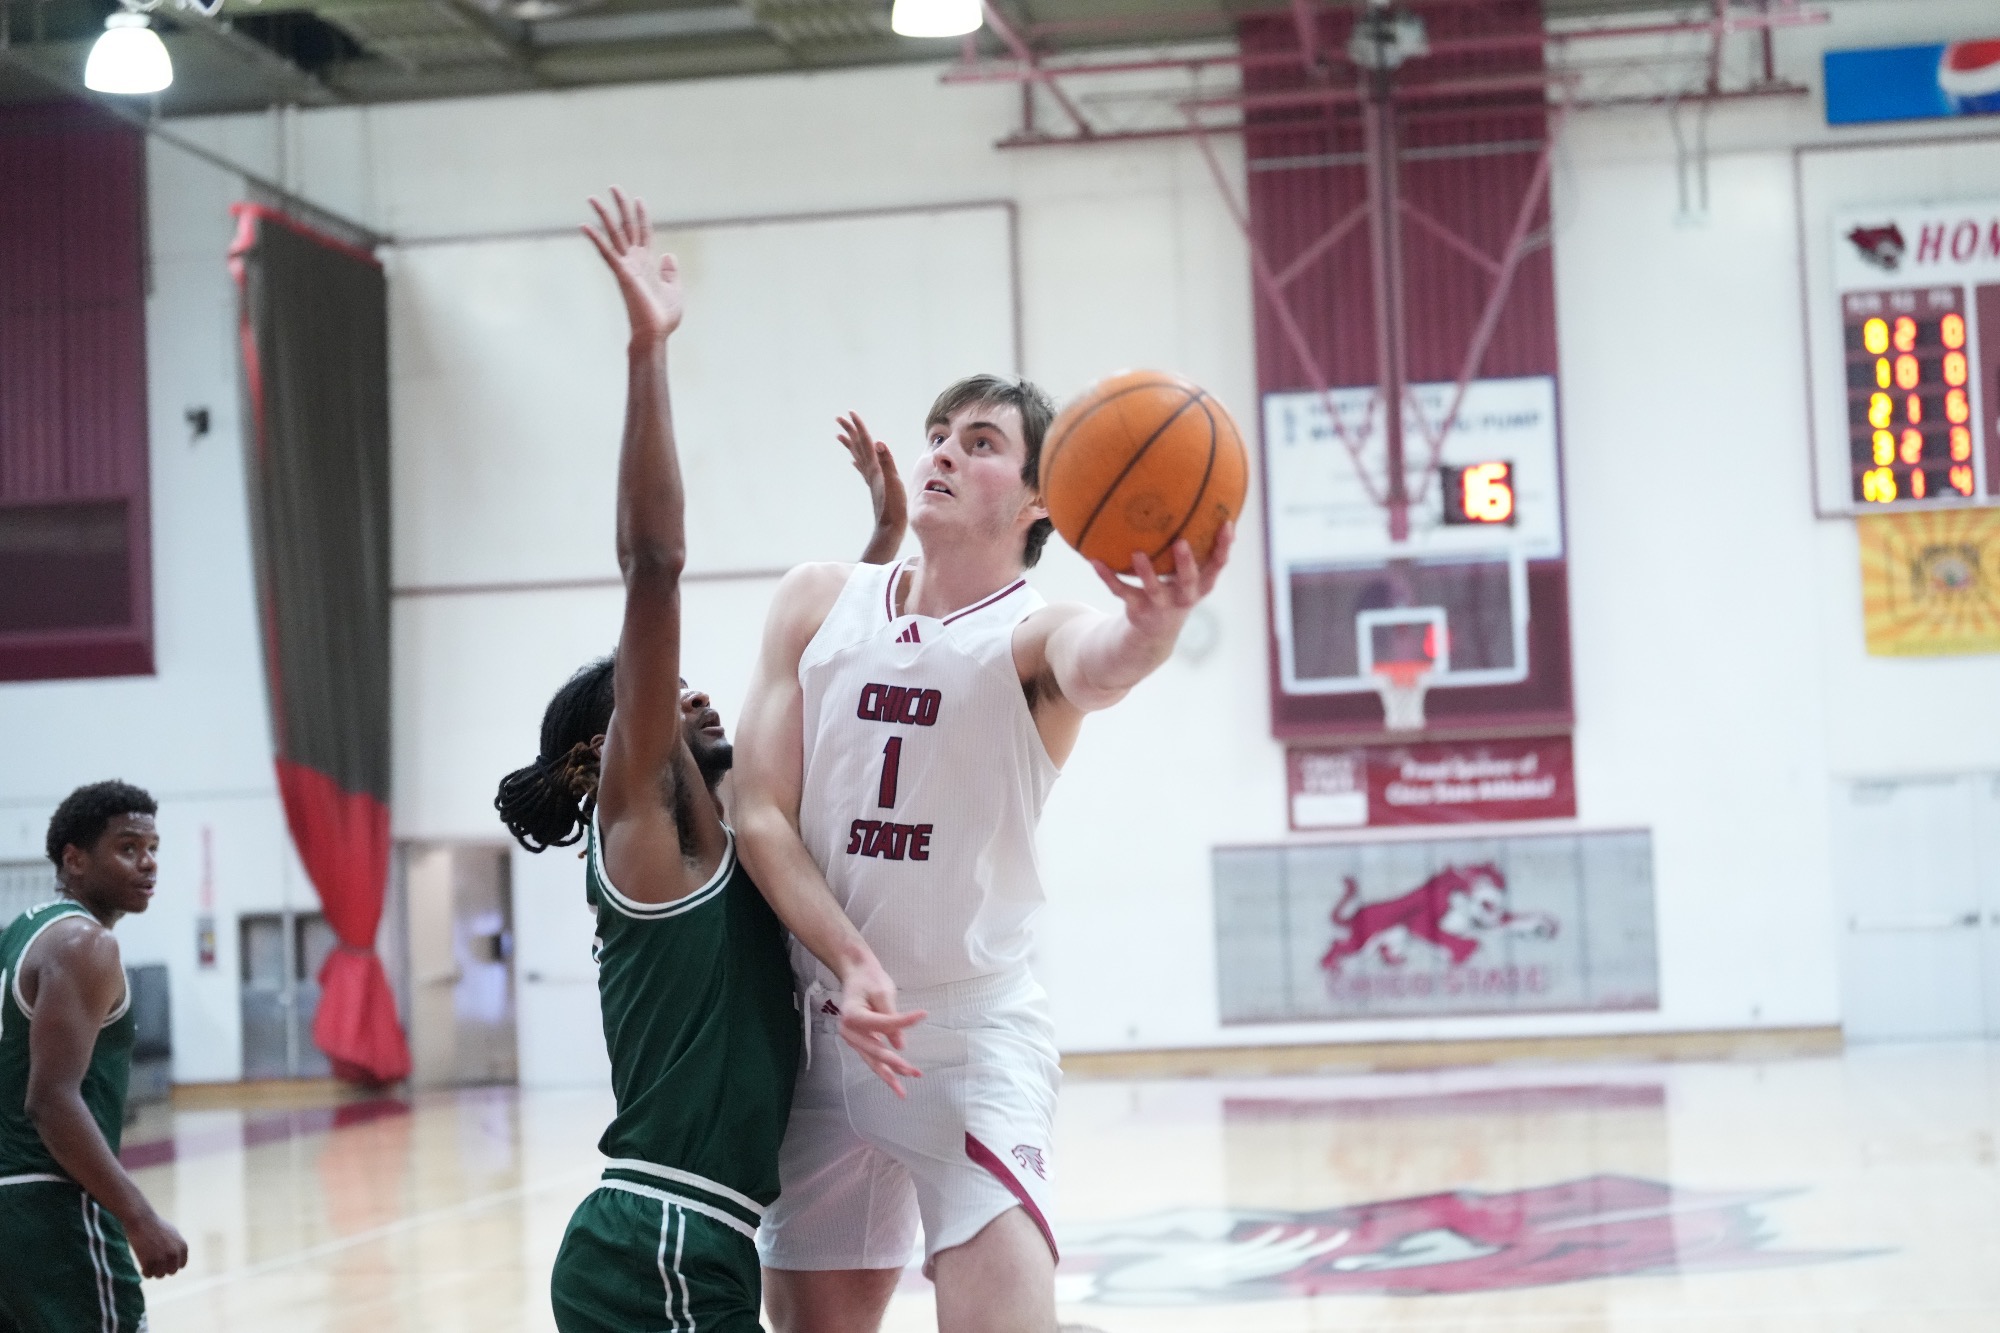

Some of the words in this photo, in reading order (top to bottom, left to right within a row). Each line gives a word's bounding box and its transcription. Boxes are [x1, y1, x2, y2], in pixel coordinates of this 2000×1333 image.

[1864, 317, 1889, 354] 0
[1893, 315, 1917, 352] 2
[1876, 357, 1891, 389] 1
[1907, 393, 1922, 425] 1
[1900, 428, 1923, 464] 2
[1461, 461, 1515, 522] 16
[1911, 468, 1926, 499] 1
[1949, 464, 1973, 497] 4
[857, 682, 942, 726] CHICO
[877, 736, 903, 809] 1
[846, 818, 933, 861] STATE
